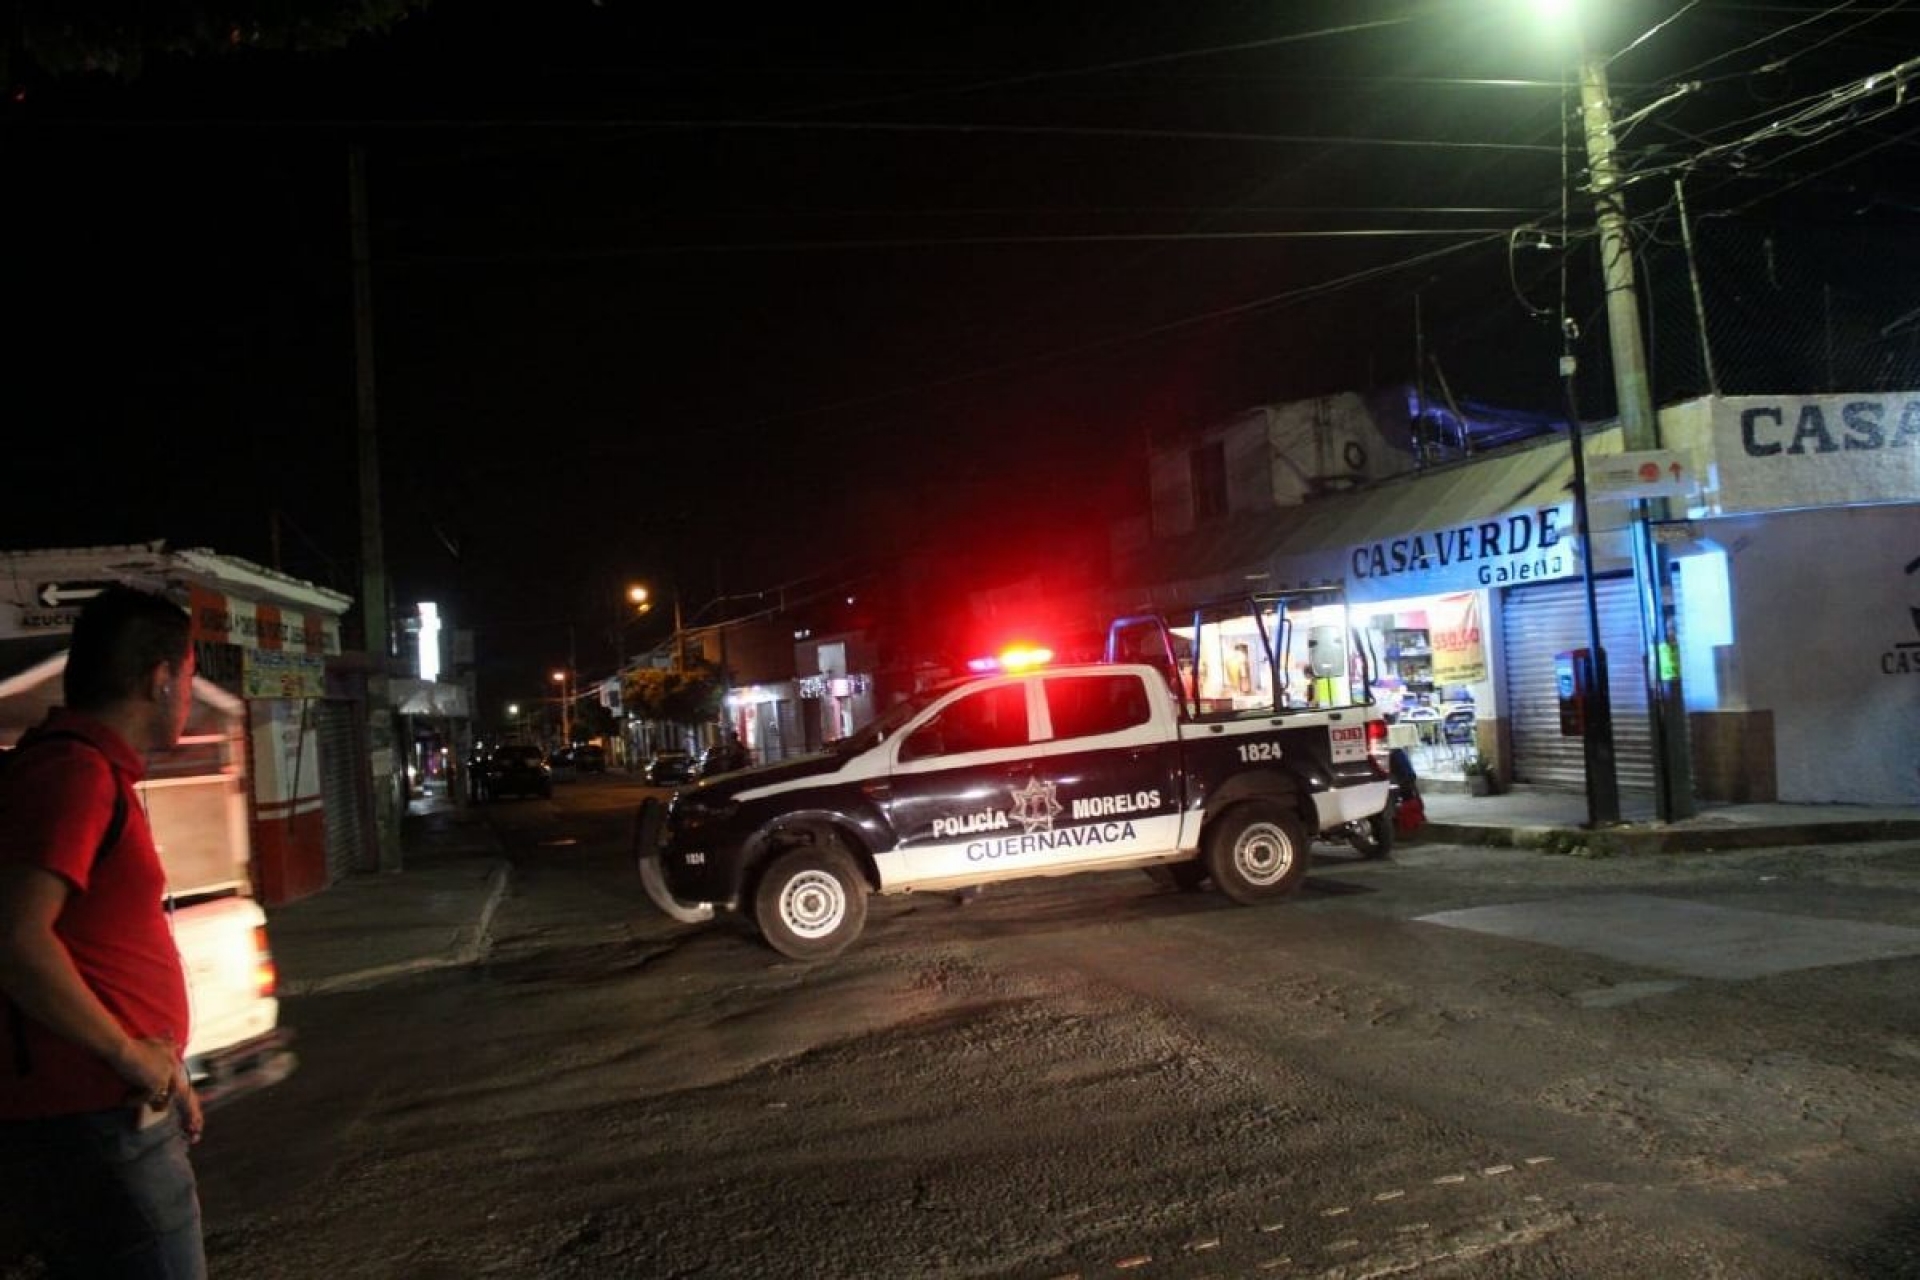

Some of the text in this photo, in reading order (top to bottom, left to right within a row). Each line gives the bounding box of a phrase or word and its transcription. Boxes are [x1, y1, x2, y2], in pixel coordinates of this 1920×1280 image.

[1352, 507, 1560, 579] CASA VERDE
[1238, 741, 1282, 762] 1824
[1072, 789, 1161, 819] MORELOS
[966, 821, 1137, 862] CUERNAVACA
